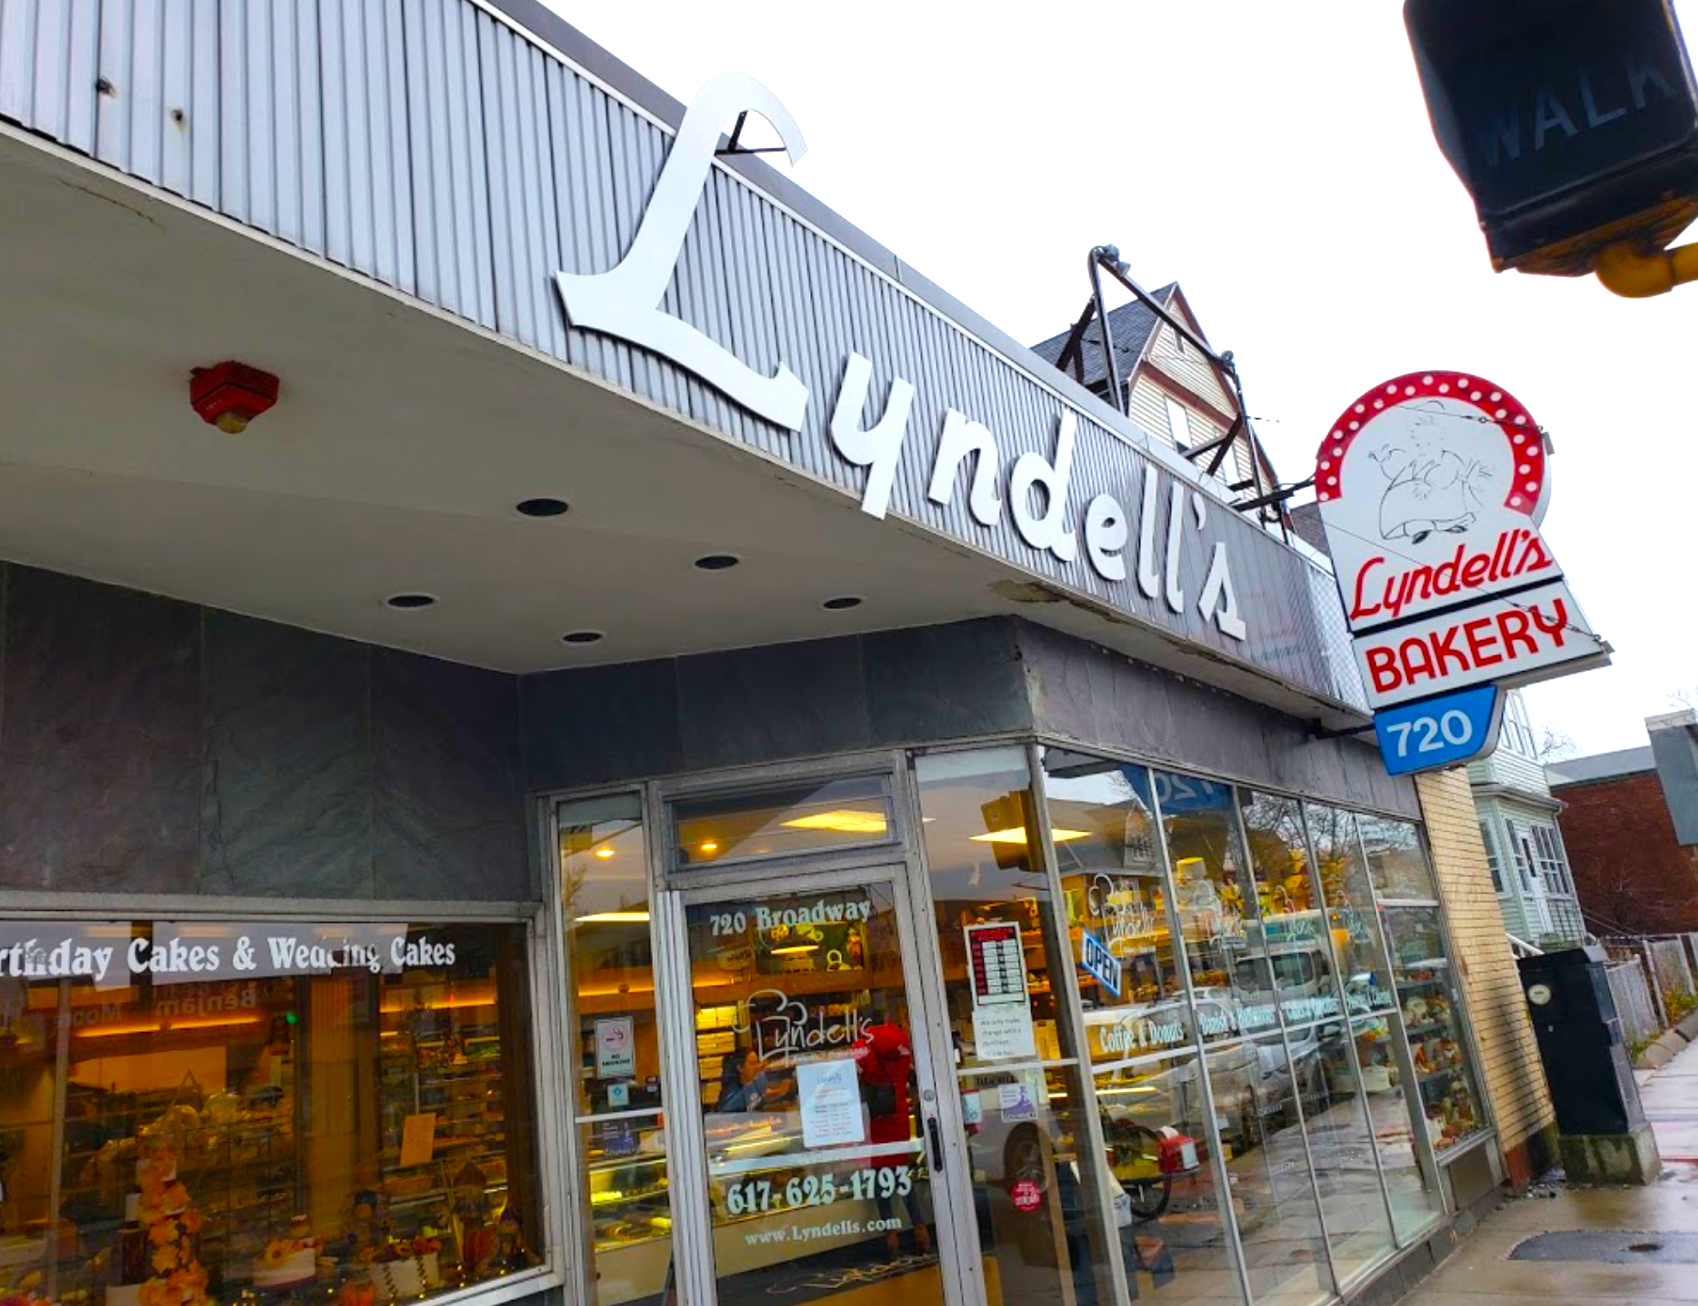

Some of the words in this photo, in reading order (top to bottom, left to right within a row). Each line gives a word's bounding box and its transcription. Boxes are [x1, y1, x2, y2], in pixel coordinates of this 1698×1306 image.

[1485, 60, 1676, 167] WALK
[554, 70, 1246, 641] Lyndell's
[1349, 528, 1552, 621] Lyndell's
[1365, 597, 1569, 694] BAKERY
[1386, 709, 1473, 757] 720
[710, 911, 746, 936] 720
[755, 900, 871, 931] Broadway
[127, 937, 220, 973] Cakes
[232, 936, 257, 970] &
[390, 936, 456, 968] Cakes
[1085, 938, 1119, 991] OPEN
[748, 998, 875, 1068] Lyndell's
[727, 1166, 912, 1214] 617-625-1793
[744, 1216, 902, 1246] www.Lyndells.com
